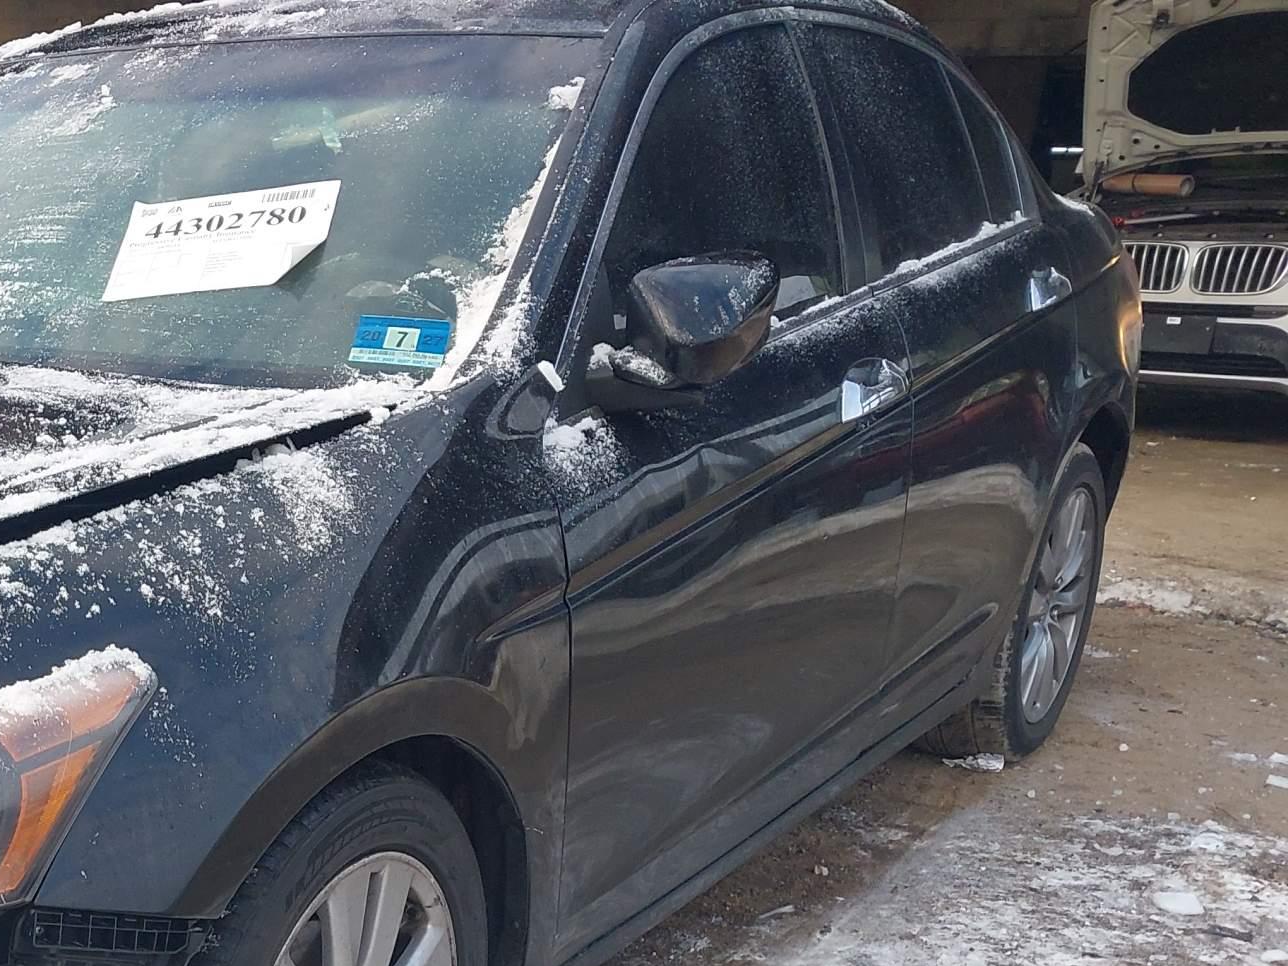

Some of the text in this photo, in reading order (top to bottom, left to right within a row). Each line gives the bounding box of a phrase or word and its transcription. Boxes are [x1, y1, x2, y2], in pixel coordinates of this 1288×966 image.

[144, 205, 307, 239] 44302780
[360, 329, 444, 348] 20 7 27
